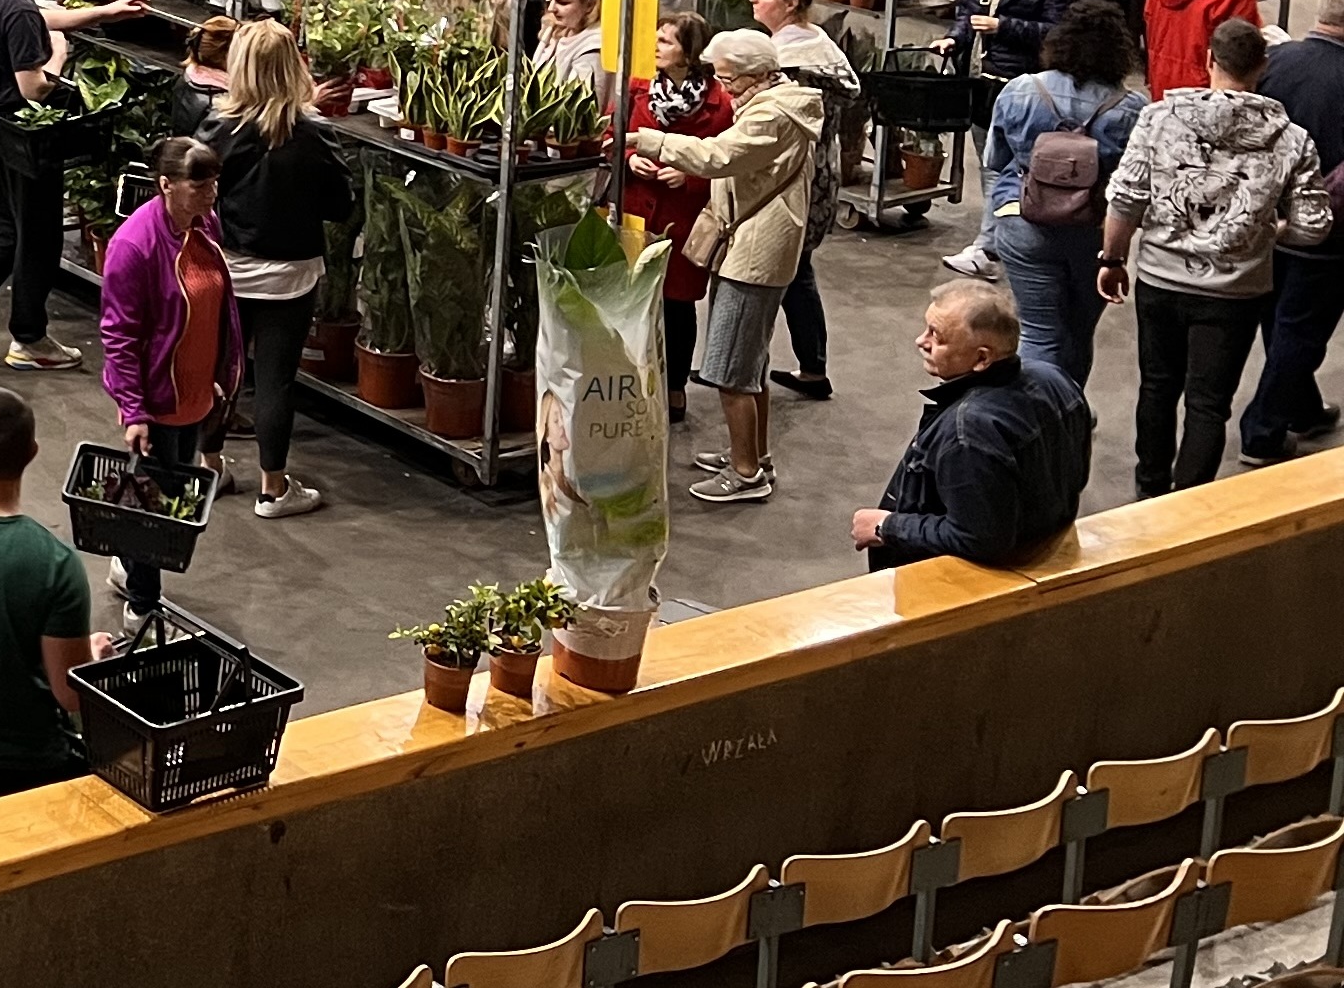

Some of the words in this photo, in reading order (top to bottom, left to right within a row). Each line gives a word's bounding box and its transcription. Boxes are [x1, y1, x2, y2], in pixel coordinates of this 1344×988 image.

[582, 374, 637, 402] AIR
[625, 398, 648, 419] SO
[589, 418, 644, 440] PURE
